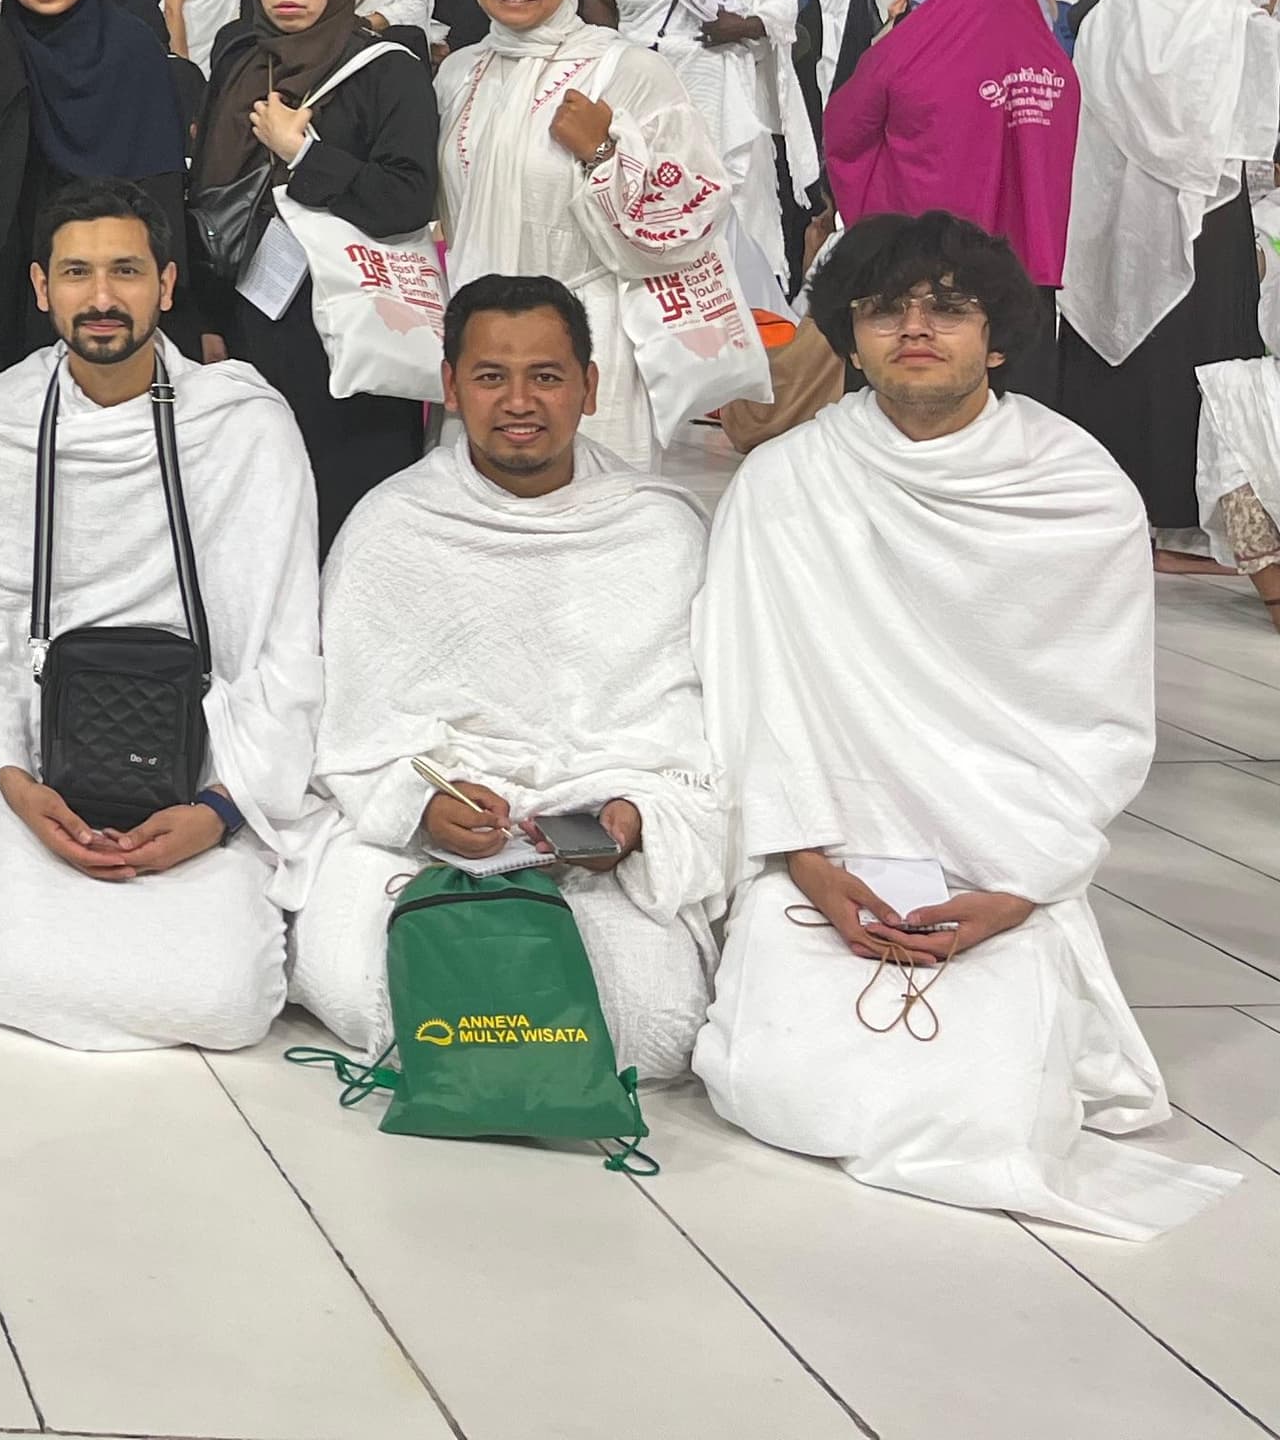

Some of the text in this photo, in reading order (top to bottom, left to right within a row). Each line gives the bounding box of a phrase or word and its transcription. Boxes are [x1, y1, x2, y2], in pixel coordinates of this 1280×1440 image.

[386, 252, 427, 264] Middle
[389, 263, 416, 273] East
[394, 274, 429, 287] Youth
[684, 268, 711, 286] East
[399, 285, 441, 300] Summit
[690, 280, 723, 299] Youth
[458, 1014, 530, 1029] ANNEVA
[459, 1028, 589, 1043] MULYA WISATA
